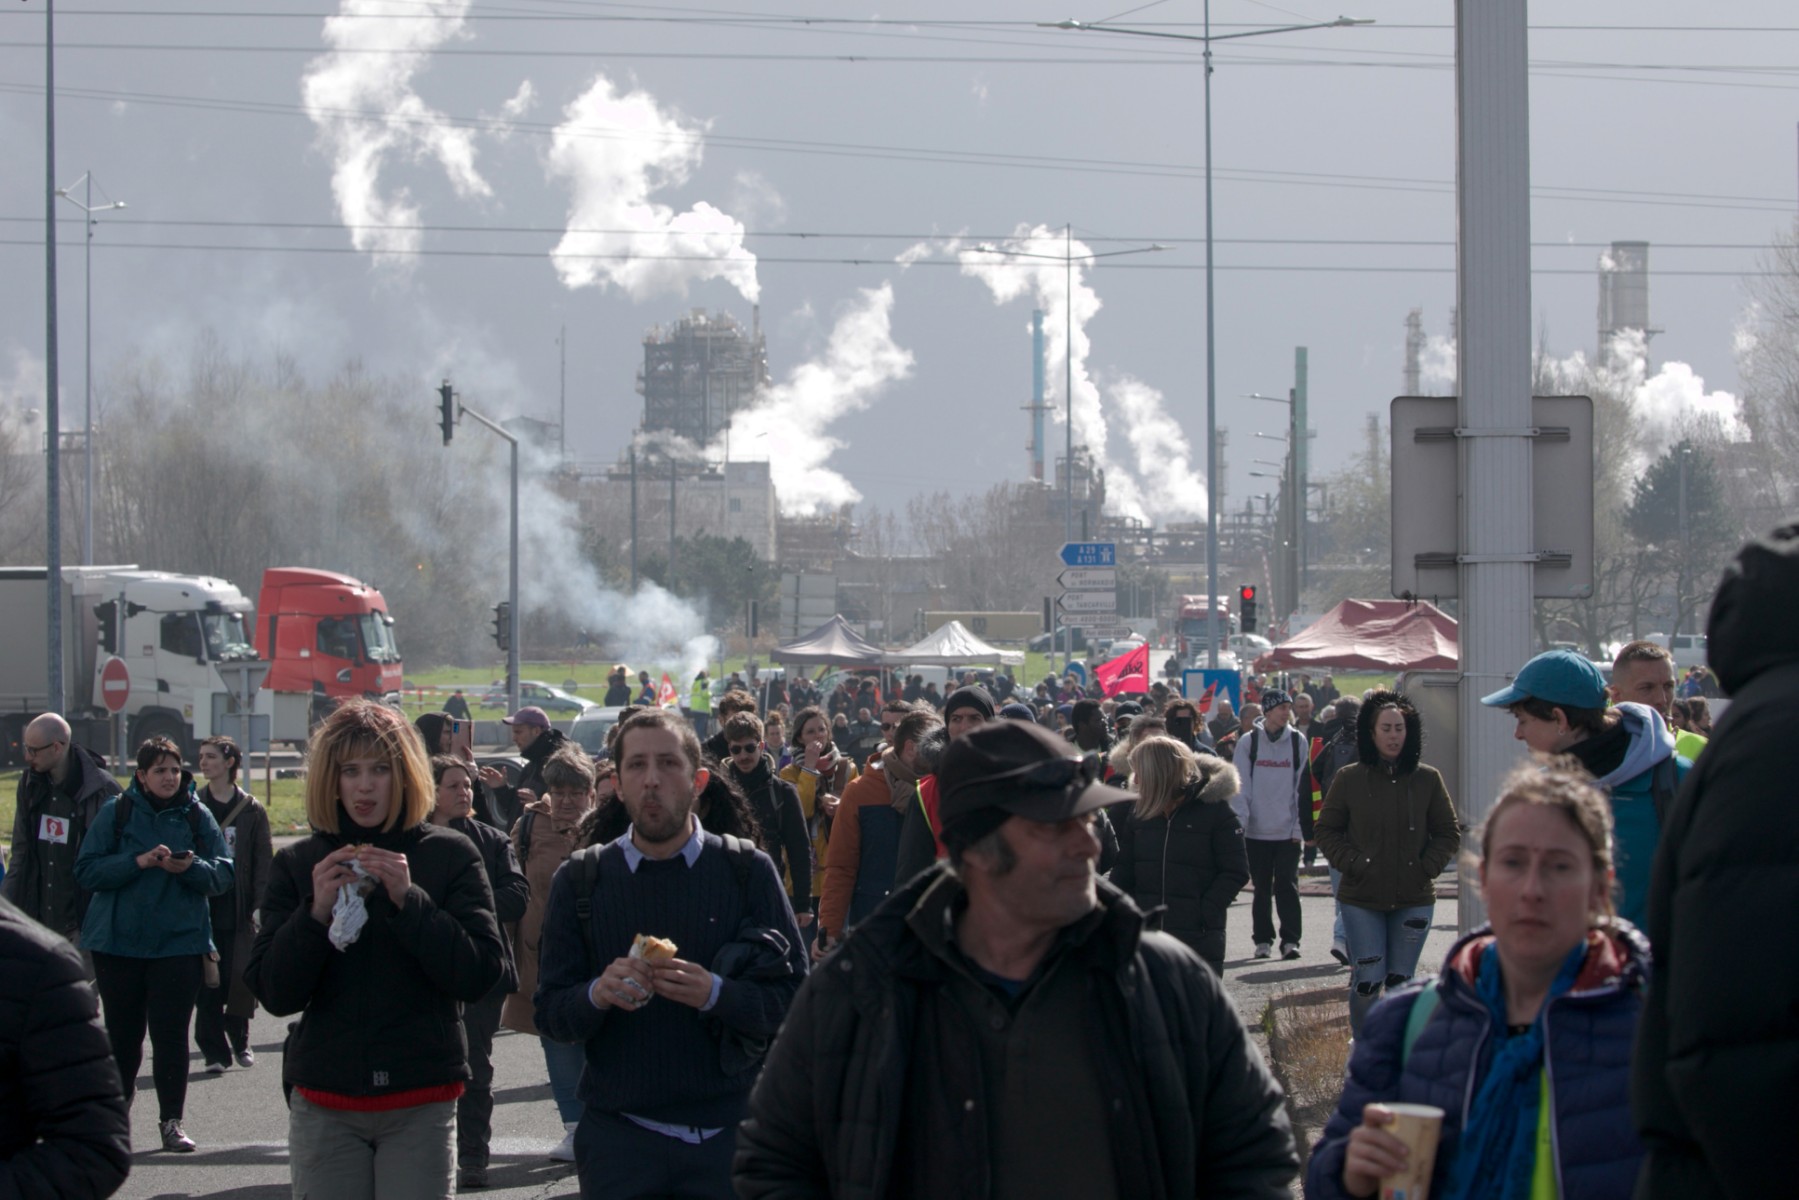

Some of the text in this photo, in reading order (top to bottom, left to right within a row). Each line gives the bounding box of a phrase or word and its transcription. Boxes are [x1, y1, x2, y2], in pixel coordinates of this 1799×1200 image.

[1079, 546, 1096, 554] A 29
[1077, 555, 1096, 563] A 131
